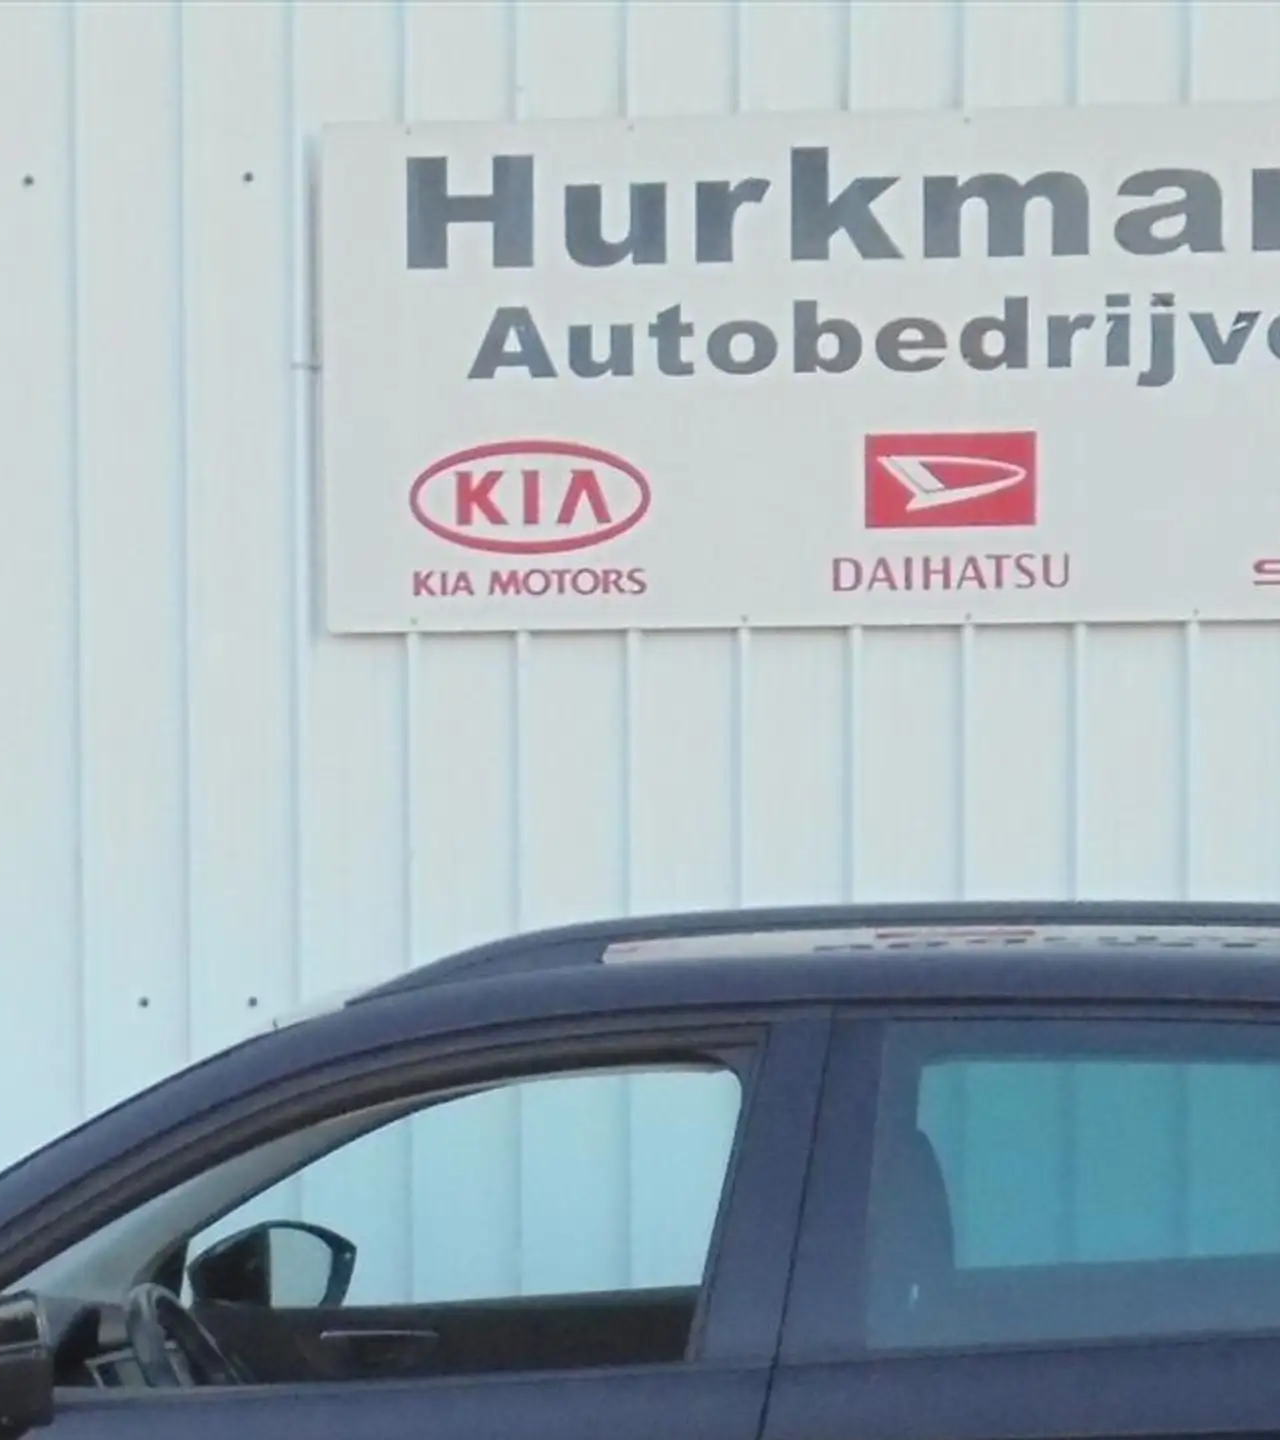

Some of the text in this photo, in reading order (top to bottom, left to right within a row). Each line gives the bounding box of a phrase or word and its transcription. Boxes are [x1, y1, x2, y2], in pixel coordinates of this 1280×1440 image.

[454, 469, 614, 526] KIA
[412, 567, 648, 597] KIA MOTORS
[832, 553, 1071, 592] DAIHATSU
